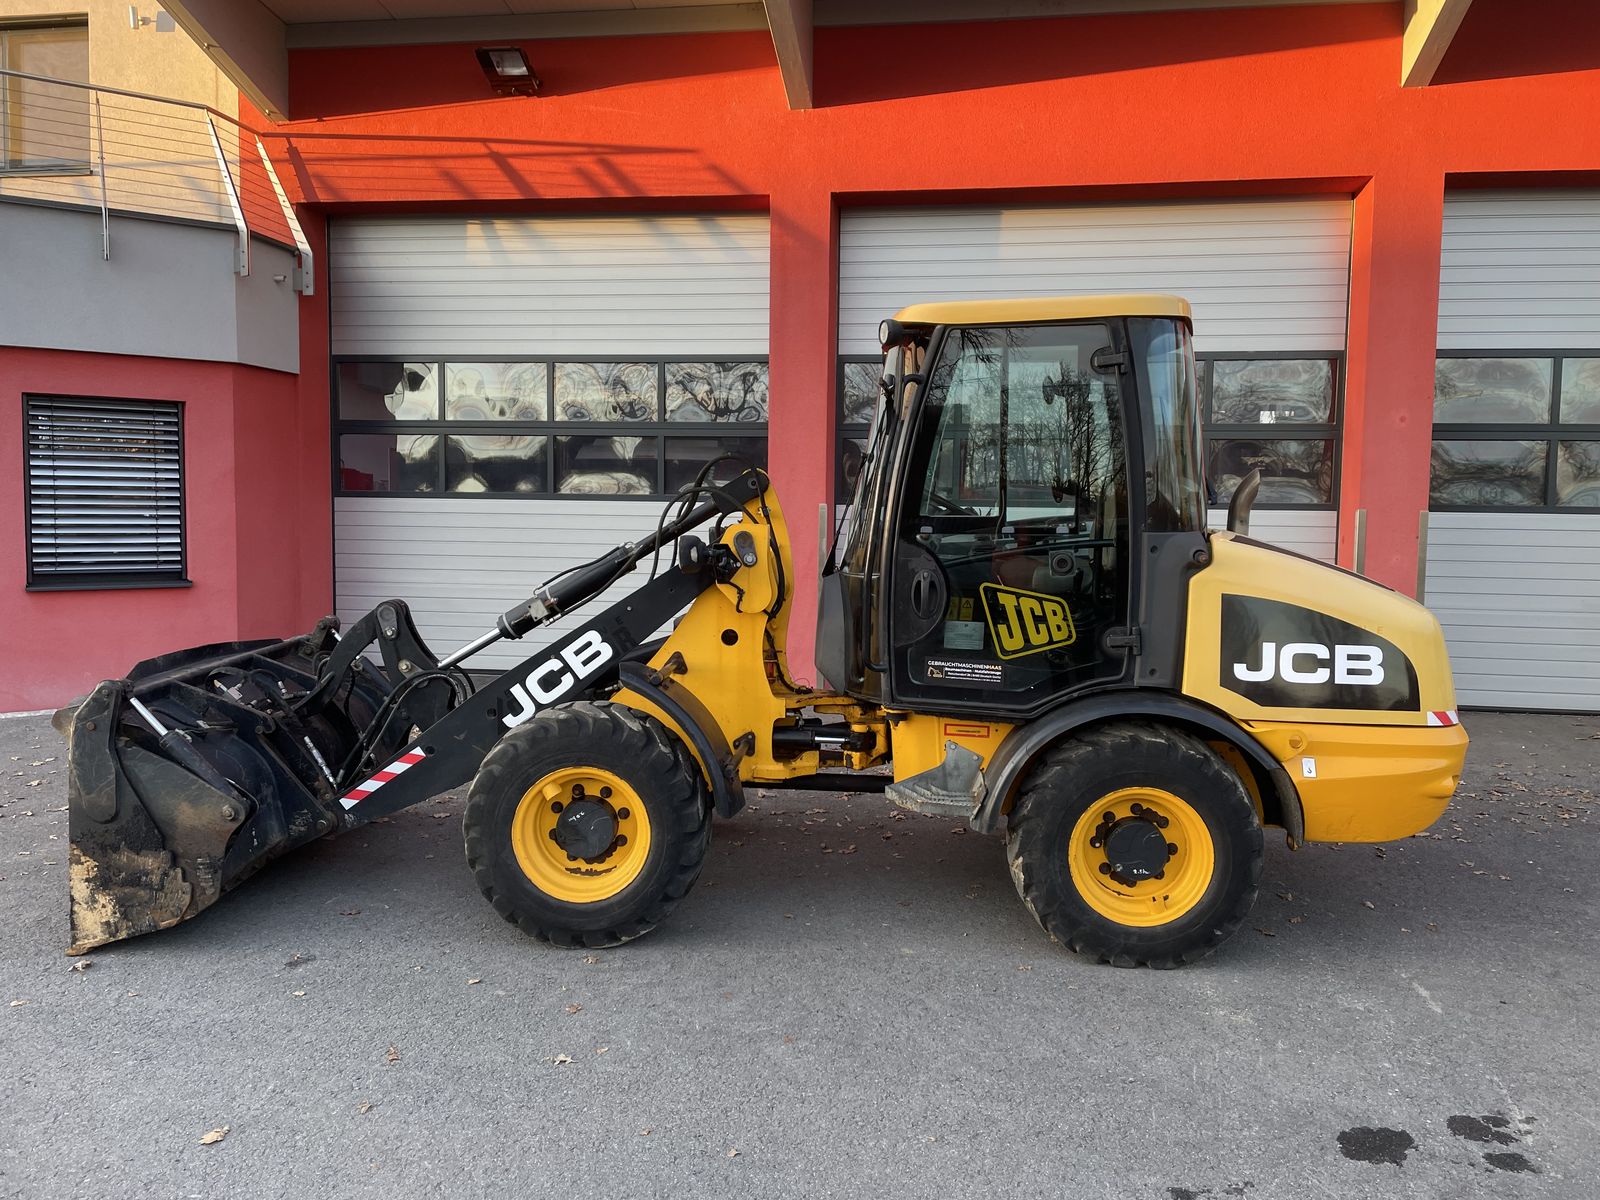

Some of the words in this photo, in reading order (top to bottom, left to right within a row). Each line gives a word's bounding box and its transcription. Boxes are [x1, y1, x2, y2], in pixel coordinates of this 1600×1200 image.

[997, 592, 1069, 651] JCB
[501, 629, 614, 728] JCB
[1233, 642, 1385, 685] JCB
